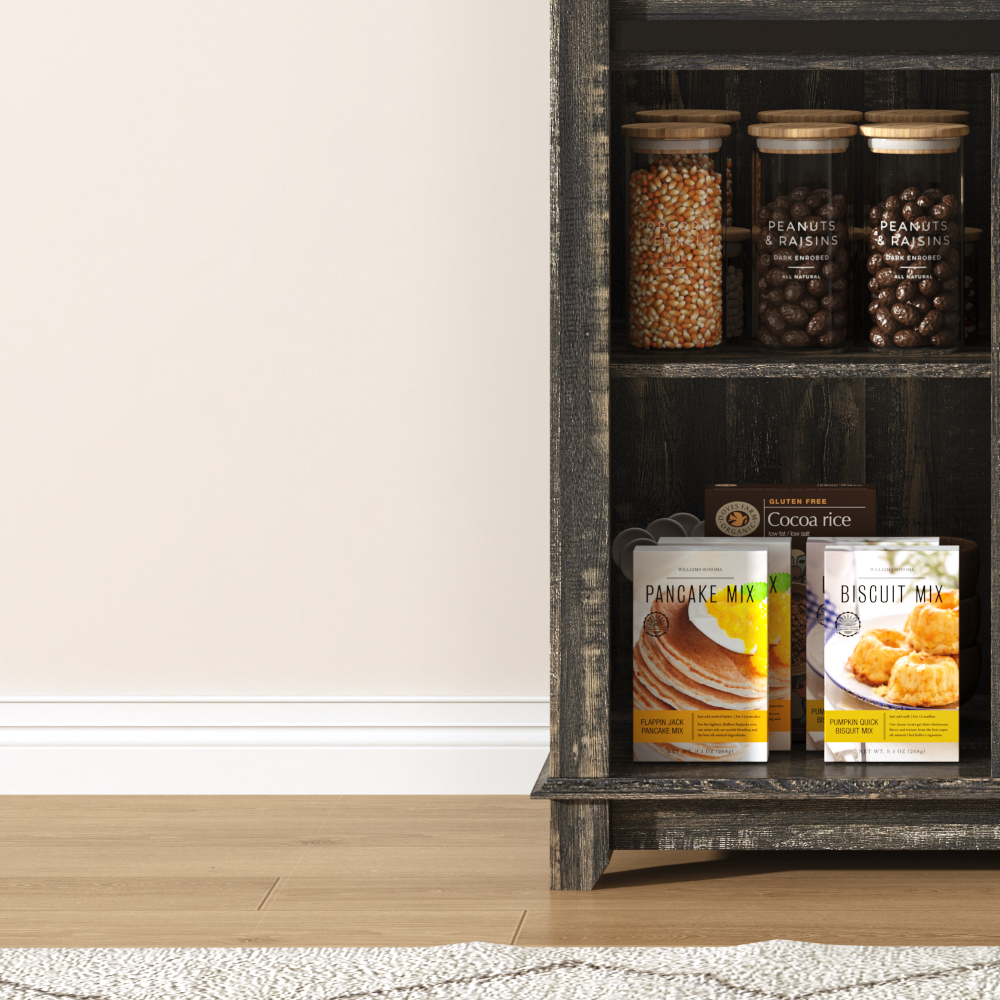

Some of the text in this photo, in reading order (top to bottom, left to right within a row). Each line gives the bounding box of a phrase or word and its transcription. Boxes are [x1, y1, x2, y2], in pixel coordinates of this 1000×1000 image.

[637, 221, 710, 231] POPCORN
[768, 220, 836, 232] PEANUTS
[880, 220, 948, 232] PEANUTS
[765, 235, 839, 247] & RAISINS
[877, 235, 950, 247] & RAISINS
[718, 503, 758, 521] DOVES FARM
[767, 511, 852, 527] Cocoa rice
[720, 522, 756, 535] ORGANIC
[645, 584, 754, 603] PANCAKE MIX
[841, 584, 943, 603] BISCUIT MIX
[829, 718, 879, 726] PUMPKIN QUICK
[641, 727, 684, 735] PANCAKE MIX
[835, 727, 873, 735] BISQUIT MIX
